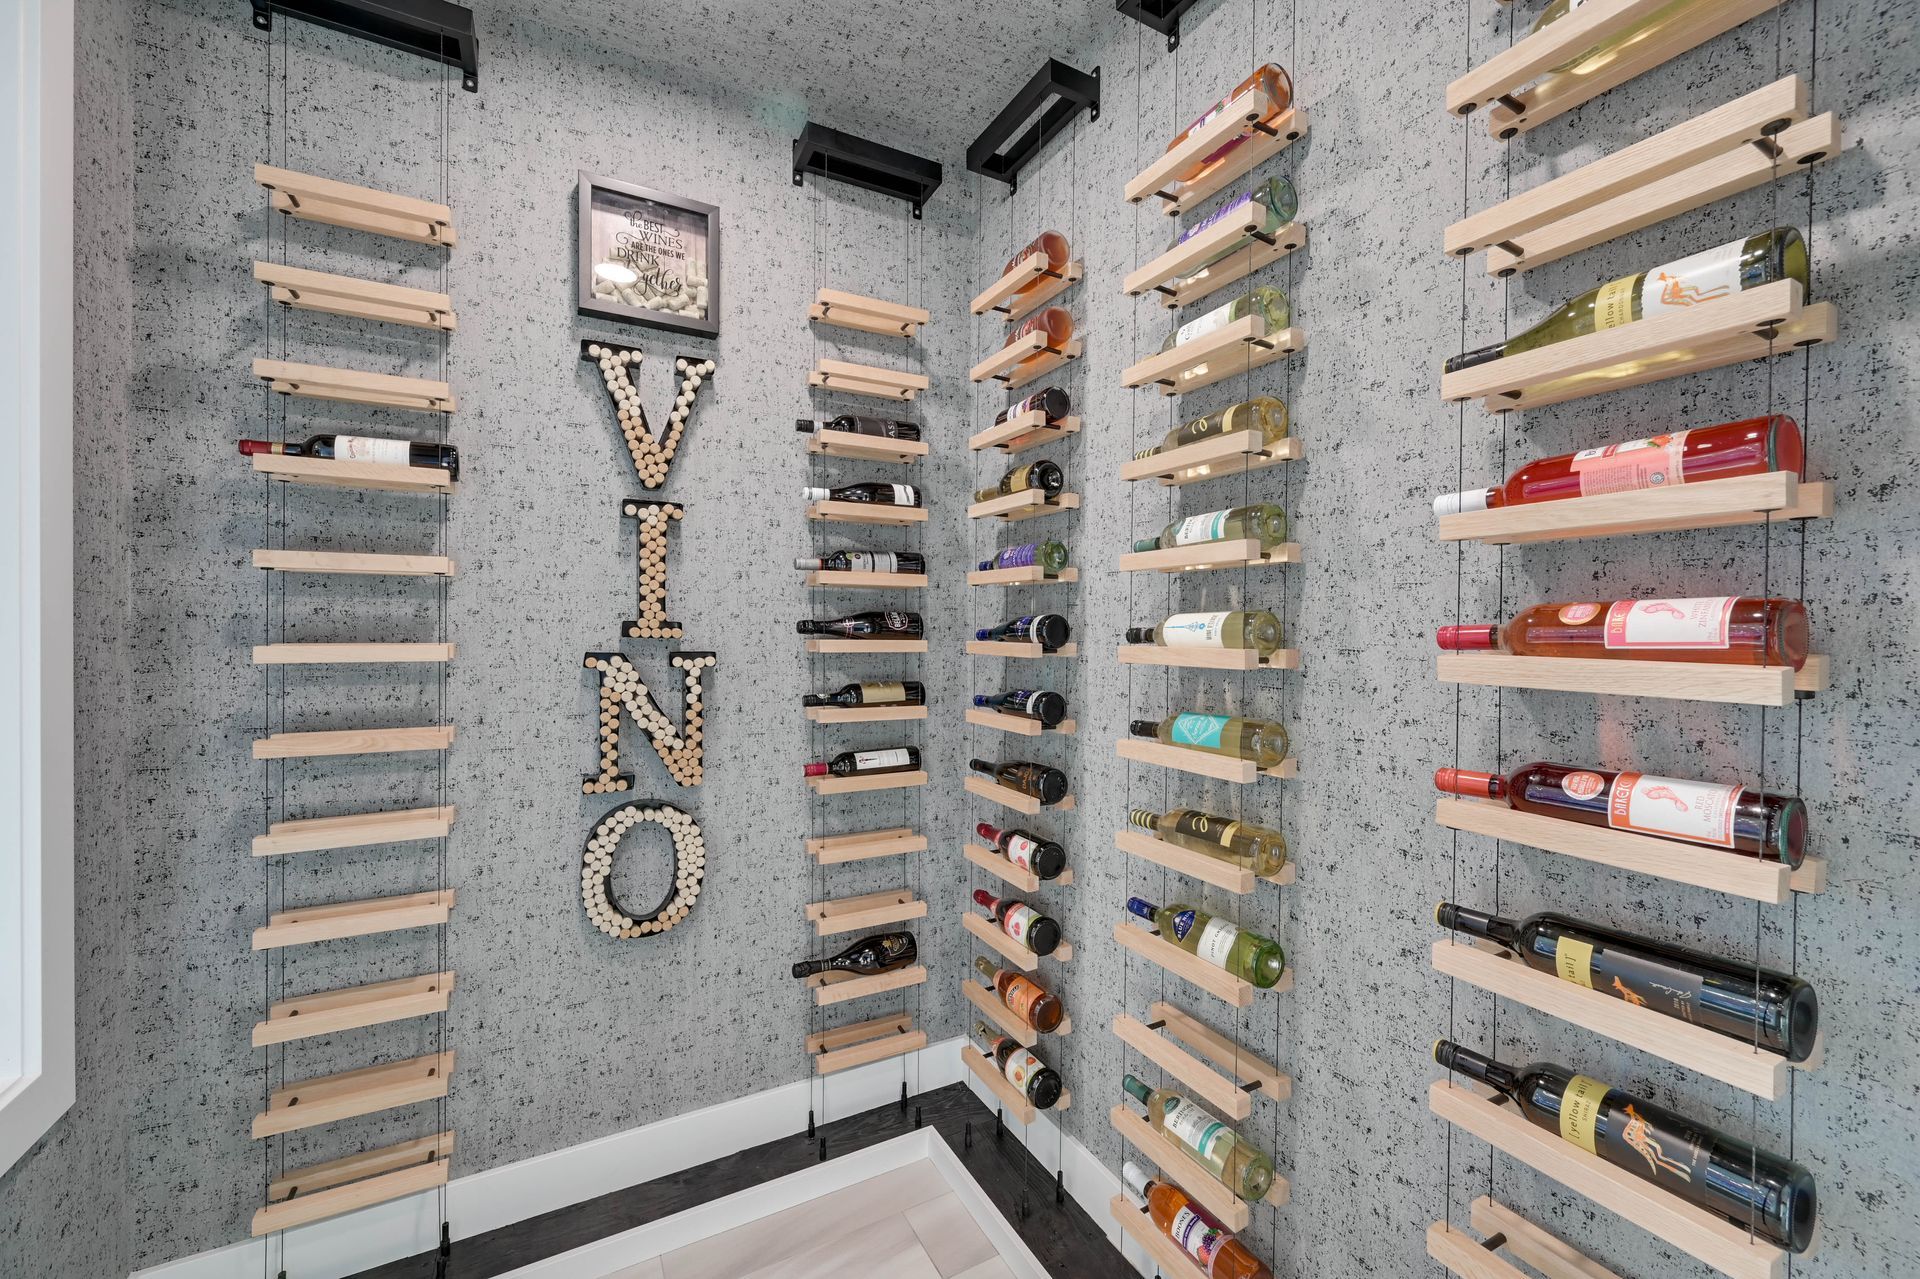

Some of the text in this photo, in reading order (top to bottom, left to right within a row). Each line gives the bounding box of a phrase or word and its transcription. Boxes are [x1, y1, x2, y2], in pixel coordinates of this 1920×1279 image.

[643, 220, 665, 233] BEST
[639, 230, 683, 250] WINES
[617, 247, 660, 267] DRINK
[631, 241, 686, 261] ARE THE ONES WE
[628, 265, 682, 297] gether
[1605, 302, 1616, 329] ellow
[580, 339, 717, 940] VINO
[1177, 921, 1185, 938] BLUE
